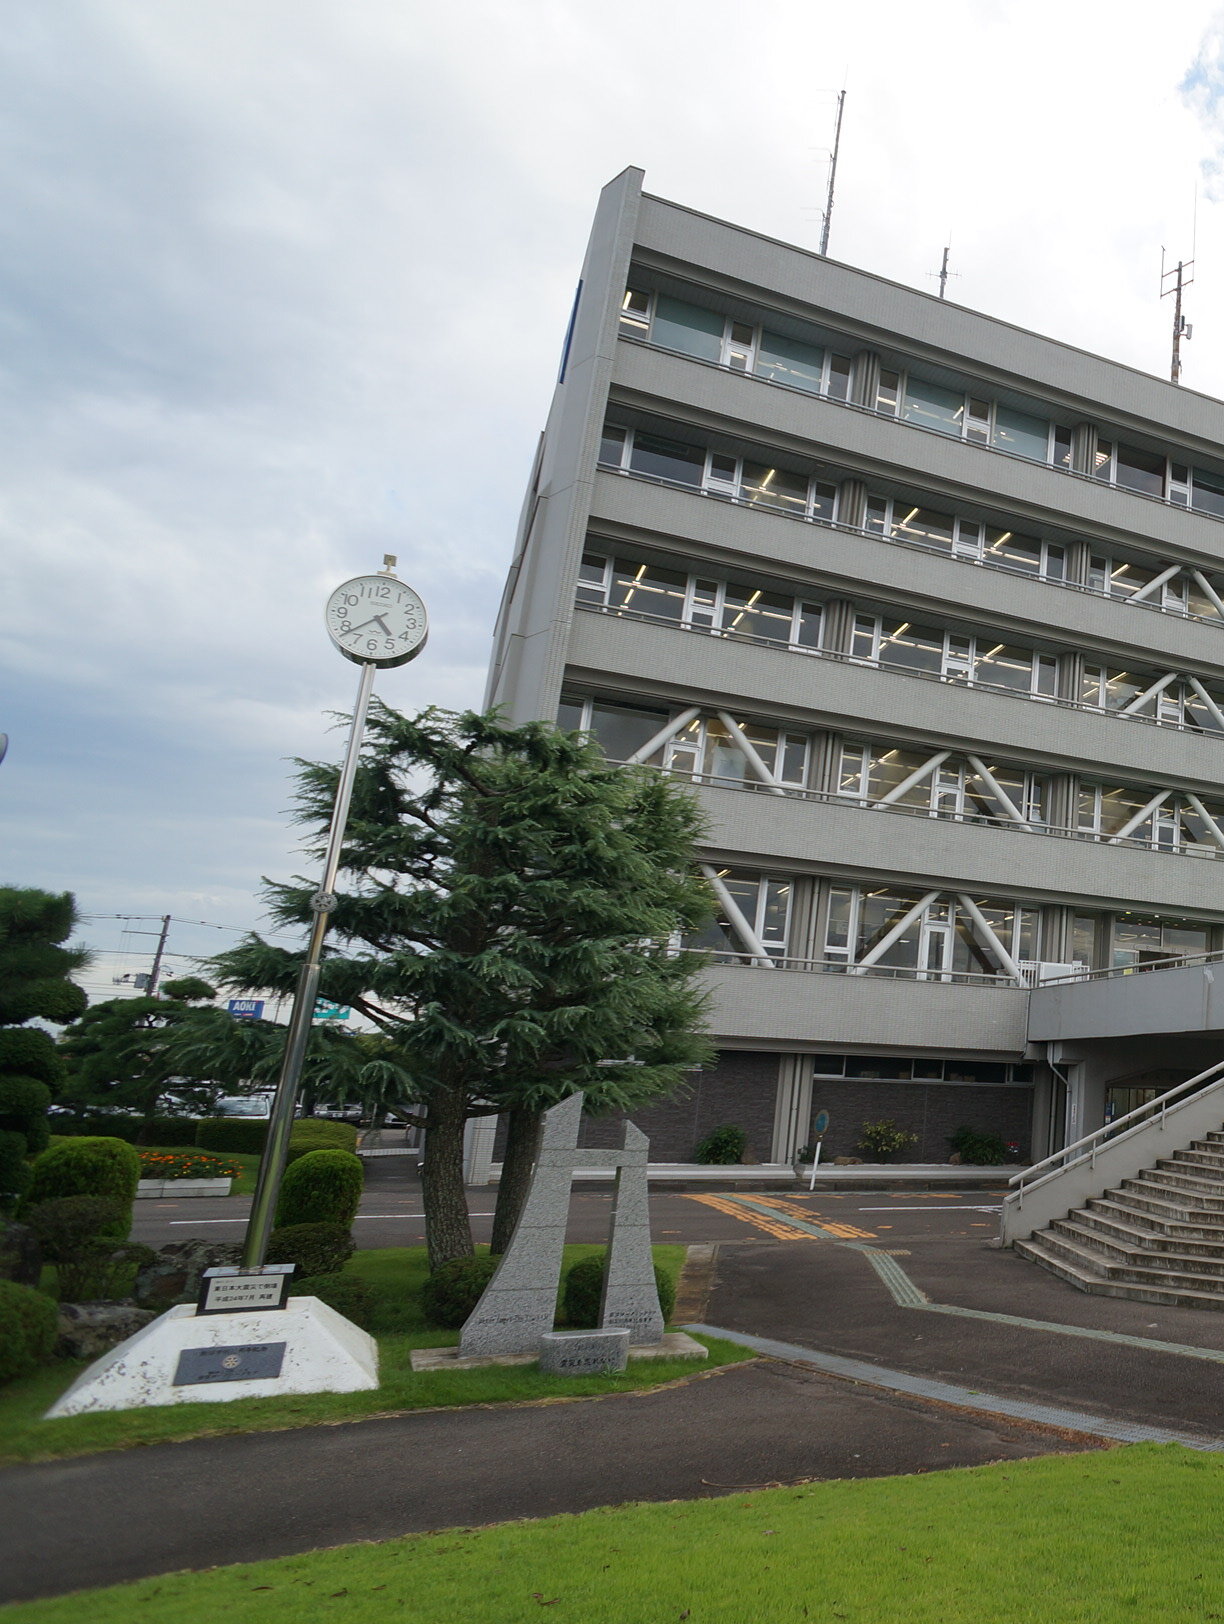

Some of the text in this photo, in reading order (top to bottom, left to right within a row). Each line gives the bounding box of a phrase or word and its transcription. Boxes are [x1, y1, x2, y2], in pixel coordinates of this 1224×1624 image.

[360, 586, 372, 598] 11
[375, 586, 391, 599] 12
[342, 594, 359, 606] 10
[336, 607, 348, 618] 9
[404, 604, 415, 615] 2
[340, 620, 352, 632] 8
[406, 618, 417, 630] 3
[352, 633, 363, 644] 7
[398, 631, 409, 641] 4
[366, 639, 377, 651] 6
[384, 638, 395, 650] 5
[233, 1001, 256, 1011] AOKI
